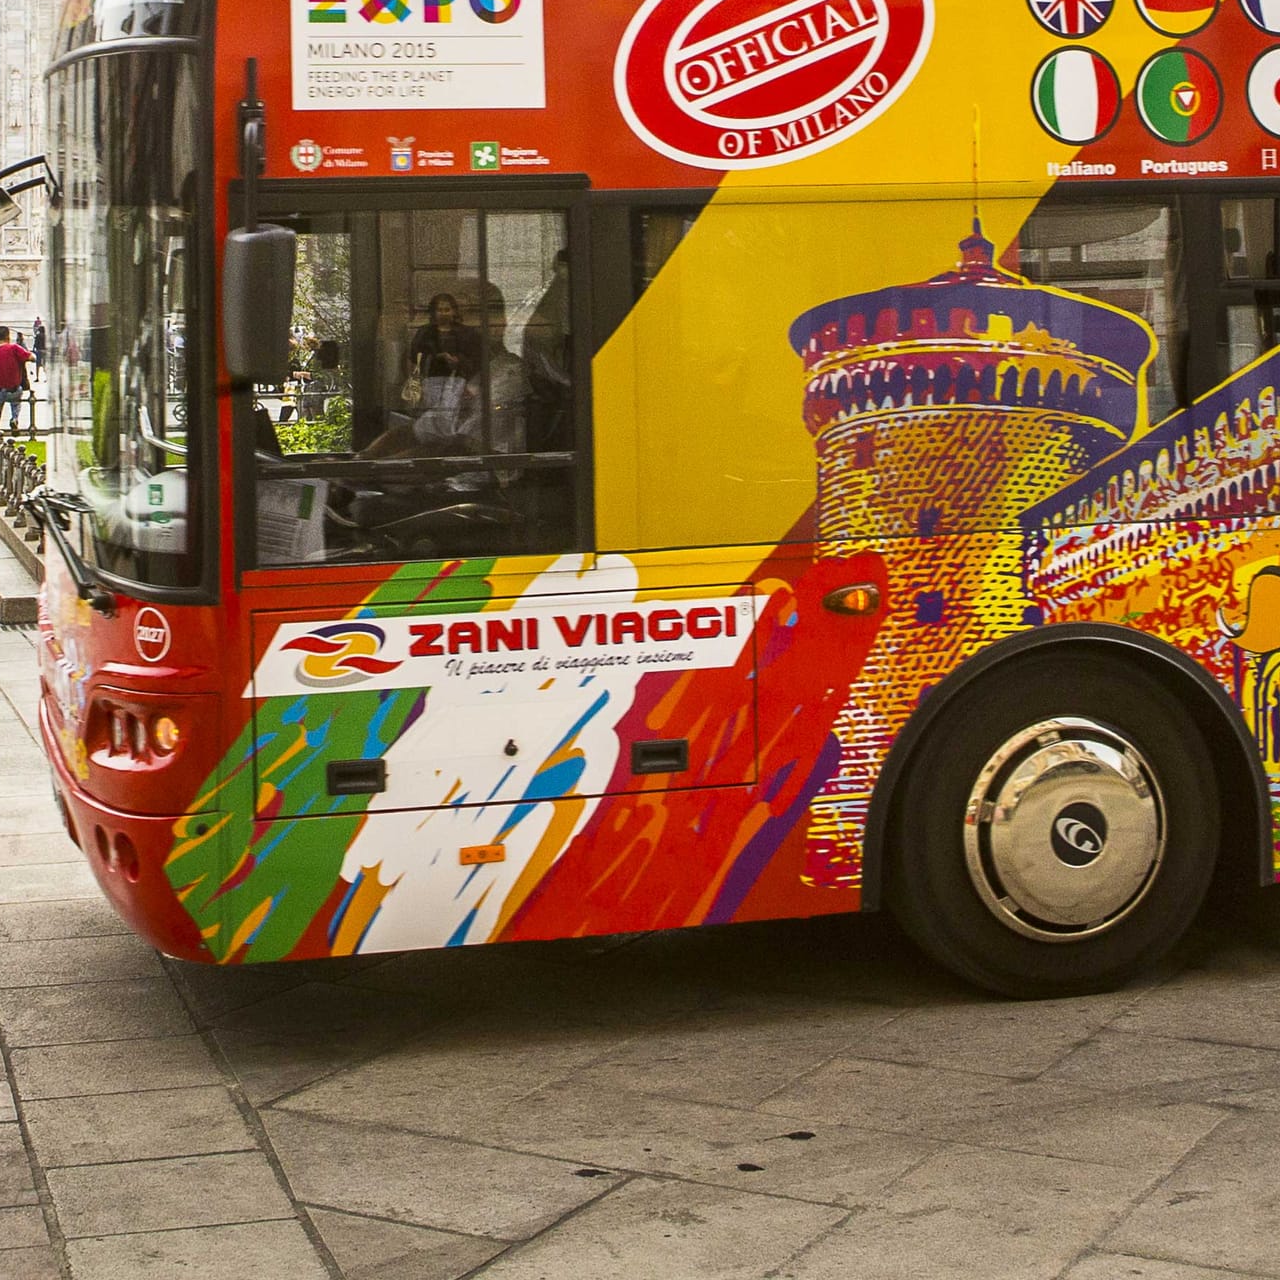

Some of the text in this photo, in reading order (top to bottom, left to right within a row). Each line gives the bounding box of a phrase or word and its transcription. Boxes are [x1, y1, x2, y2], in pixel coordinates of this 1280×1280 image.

[307, 42, 438, 59] MILANO 2015
[307, 70, 454, 83] FEEDING THE PLANET
[307, 85, 426, 99] ENERGY FOR LIFE
[718, 71, 889, 157] OF MILANO
[1047, 161, 1116, 176] Italiano
[1141, 158, 1229, 176] Portugues
[409, 605, 737, 657] ZANI VIAGGI
[444, 649, 695, 679] Il piacere di viaggiare insieme
